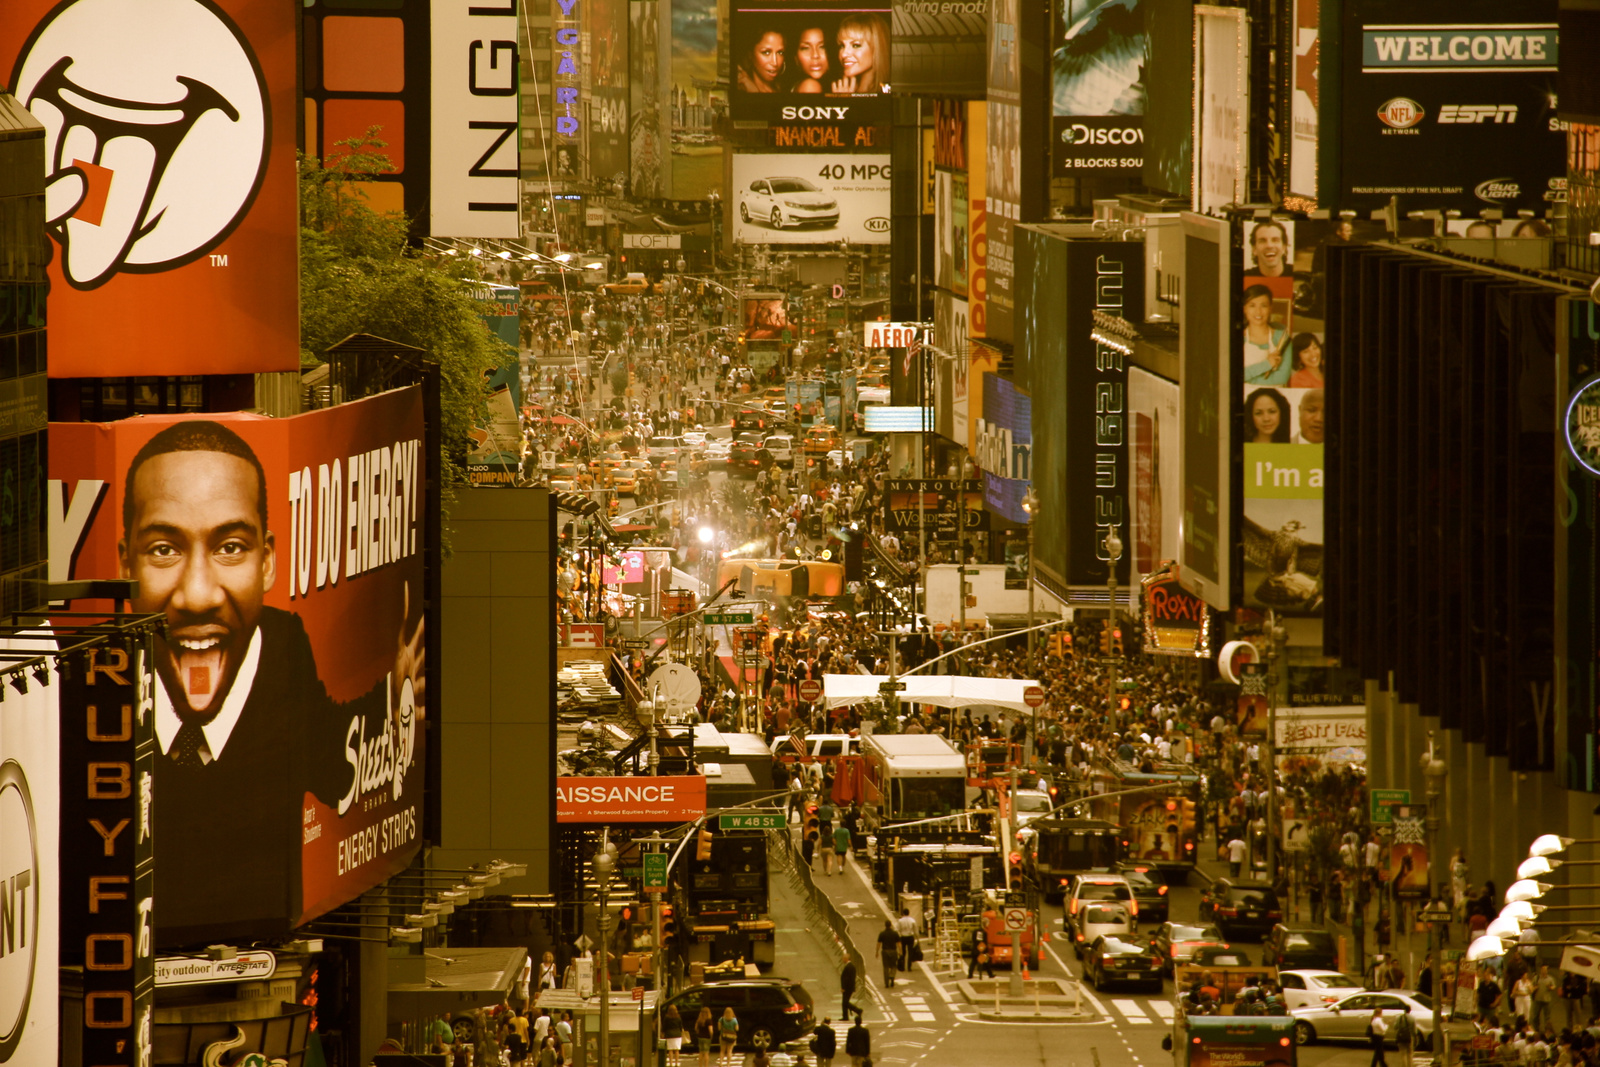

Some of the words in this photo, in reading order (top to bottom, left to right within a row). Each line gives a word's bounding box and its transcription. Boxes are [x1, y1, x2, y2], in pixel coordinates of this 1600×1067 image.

[1374, 35, 1547, 62] WELCOME
[781, 105, 850, 121] SONY
[1390, 107, 1412, 122] NFL
[1437, 104, 1518, 123] ESPN
[1065, 158, 1072, 168] 2
[1074, 158, 1118, 168] BLOCKS
[1119, 158, 1144, 168] SOU
[818, 164, 846, 180] 40
[851, 164, 892, 180] MPG
[1488, 183, 1519, 191] BUD
[1481, 190, 1521, 199] LIGHT
[869, 220, 889, 230] KIA
[631, 235, 673, 248] LOFT
[209, 254, 228, 267] TM
[1096, 254, 1124, 372] JUE
[469, 472, 517, 484] COMPANY
[1255, 460, 1300, 487] I'm
[890, 482, 983, 491] MARQUIS
[289, 465, 312, 598] TO
[316, 457, 342, 589] DO
[345, 438, 420, 578] ENERGY!
[711, 614, 722, 624] W
[735, 613, 745, 624] St
[1293, 693, 1321, 703] BLUE
[1323, 693, 1342, 703] FIN
[364, 792, 387, 812] BRAND
[732, 817, 742, 827] W
[744, 817, 760, 827] 48
[763, 817, 775, 827] St
[338, 823, 380, 877] ENERGY
[381, 805, 416, 855] STRIPS
[172, 963, 212, 976] outdoor
[216, 961, 269, 972] INTERSTATE
